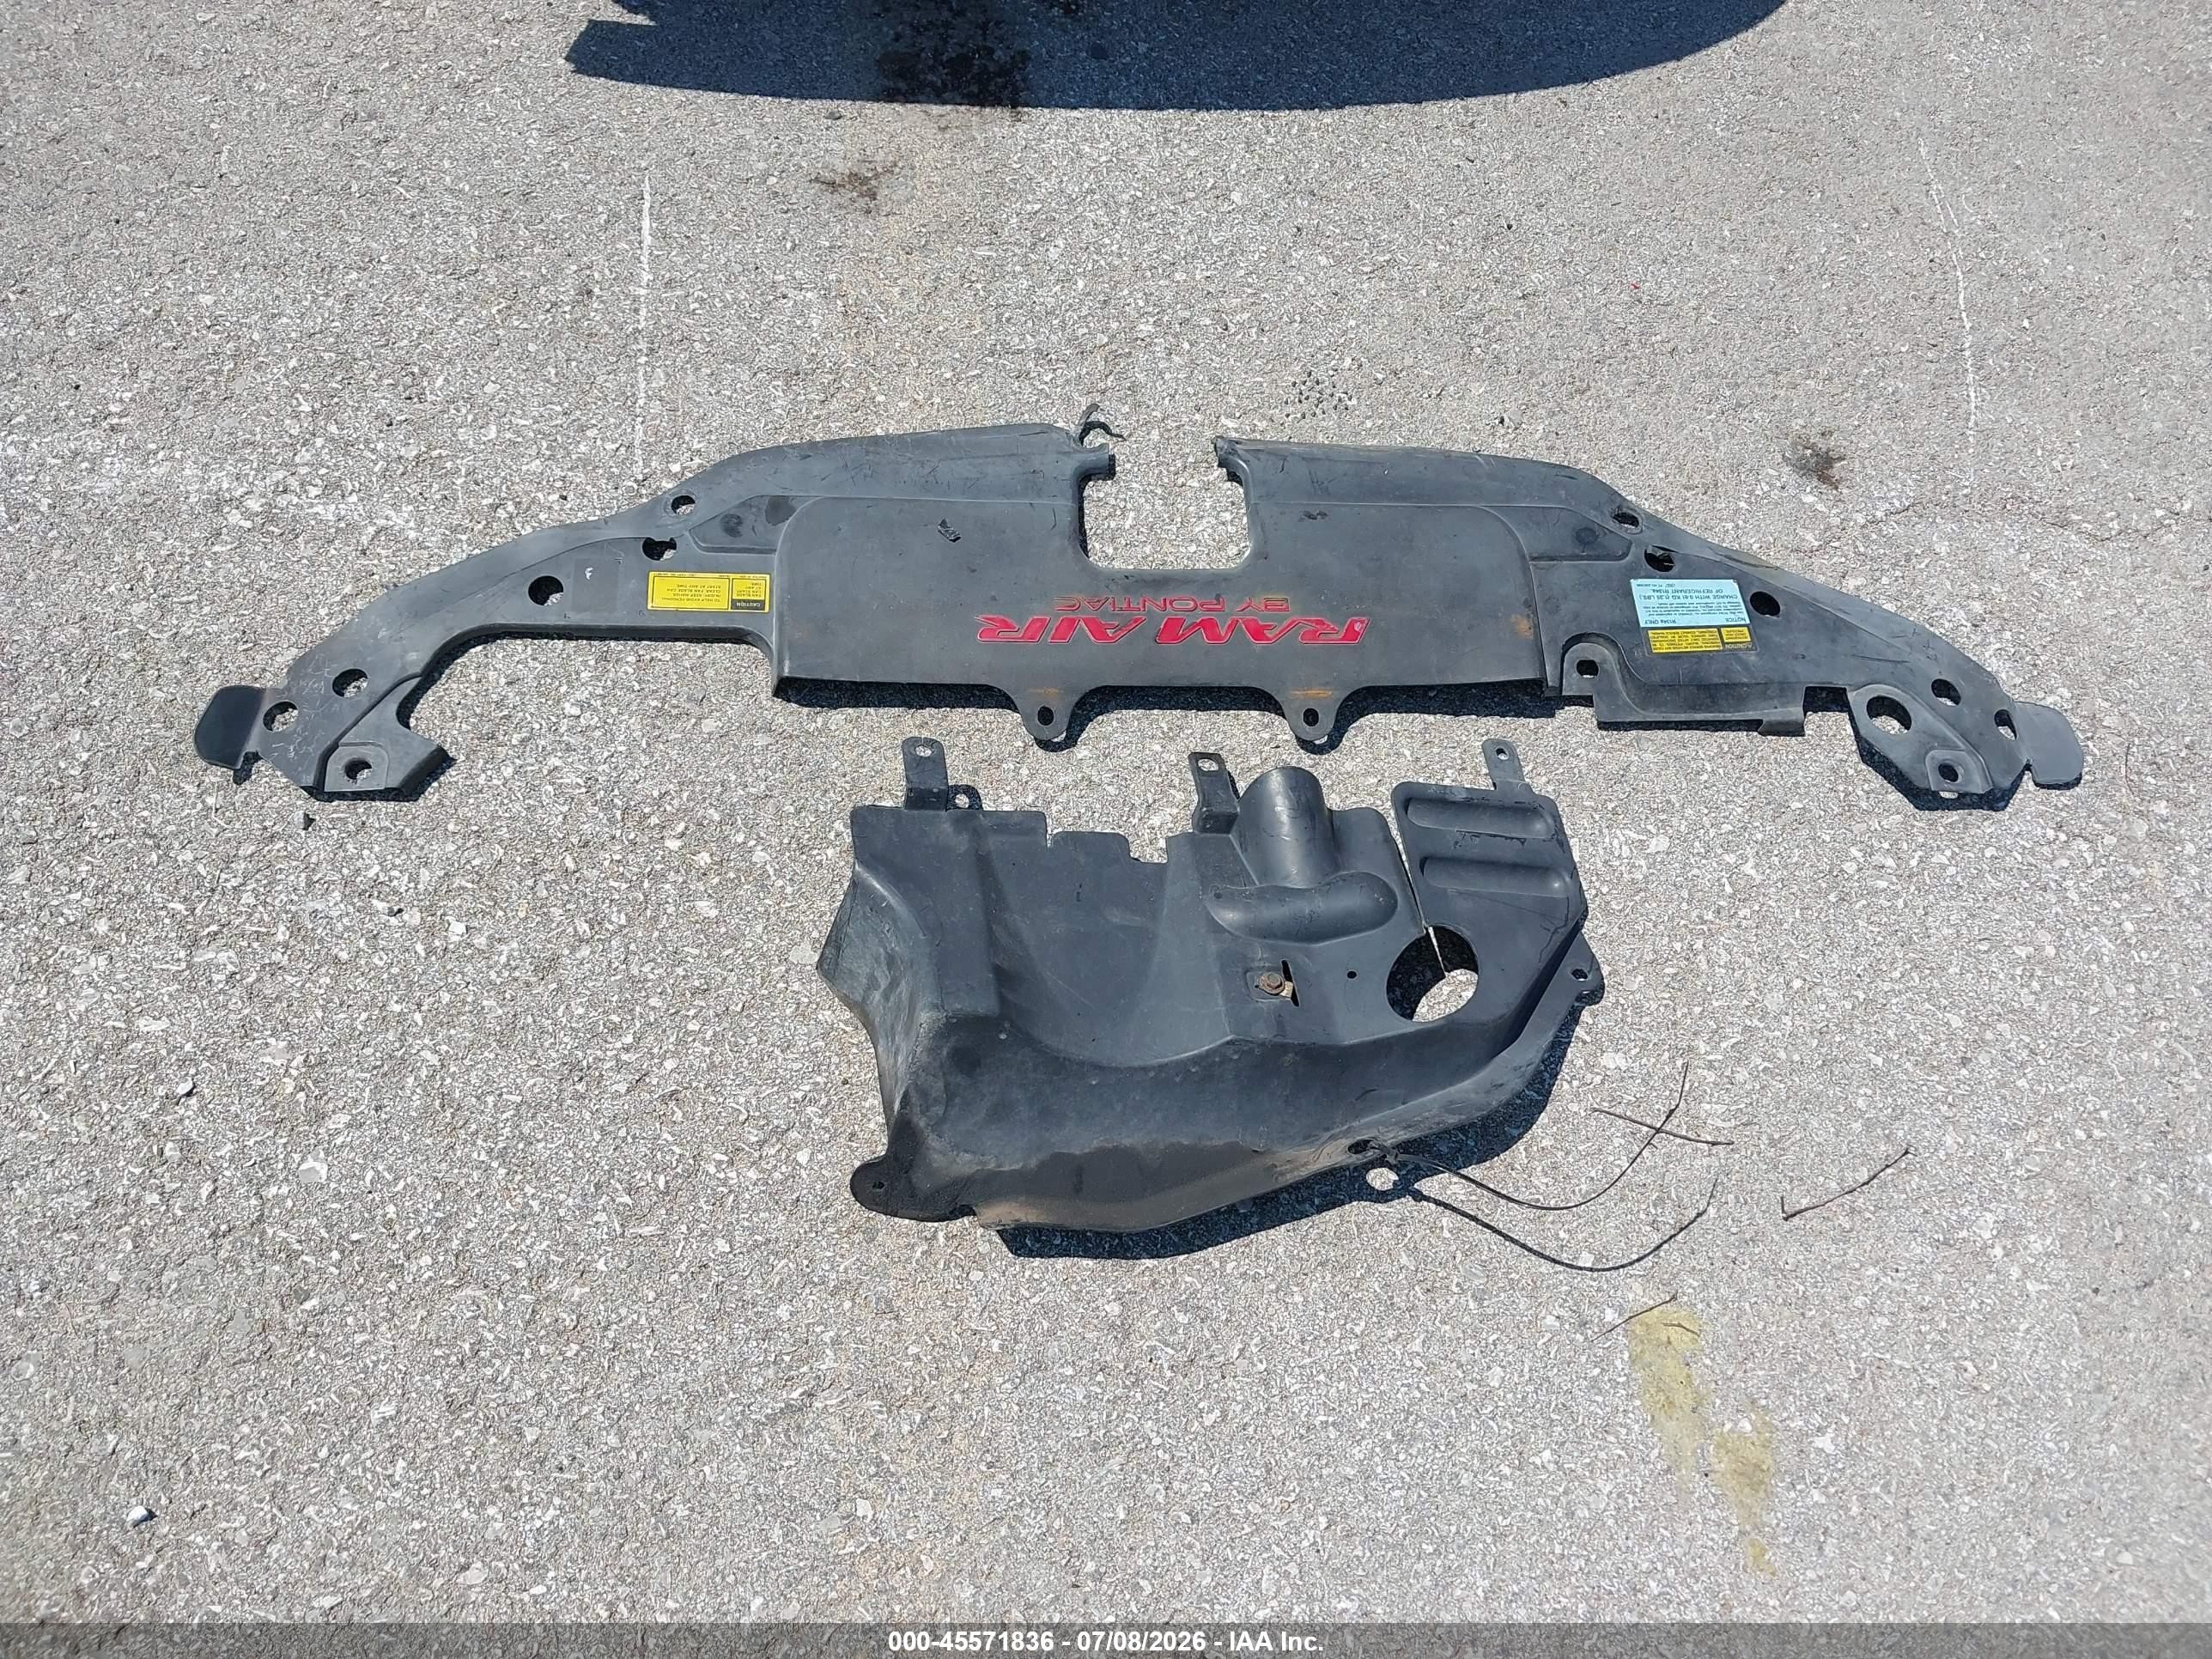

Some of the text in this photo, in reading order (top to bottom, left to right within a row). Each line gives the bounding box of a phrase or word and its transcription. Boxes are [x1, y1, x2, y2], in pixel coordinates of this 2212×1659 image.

[1052, 596, 1291, 613] BY PONTIAC
[974, 615, 1370, 645] RAM AIR
